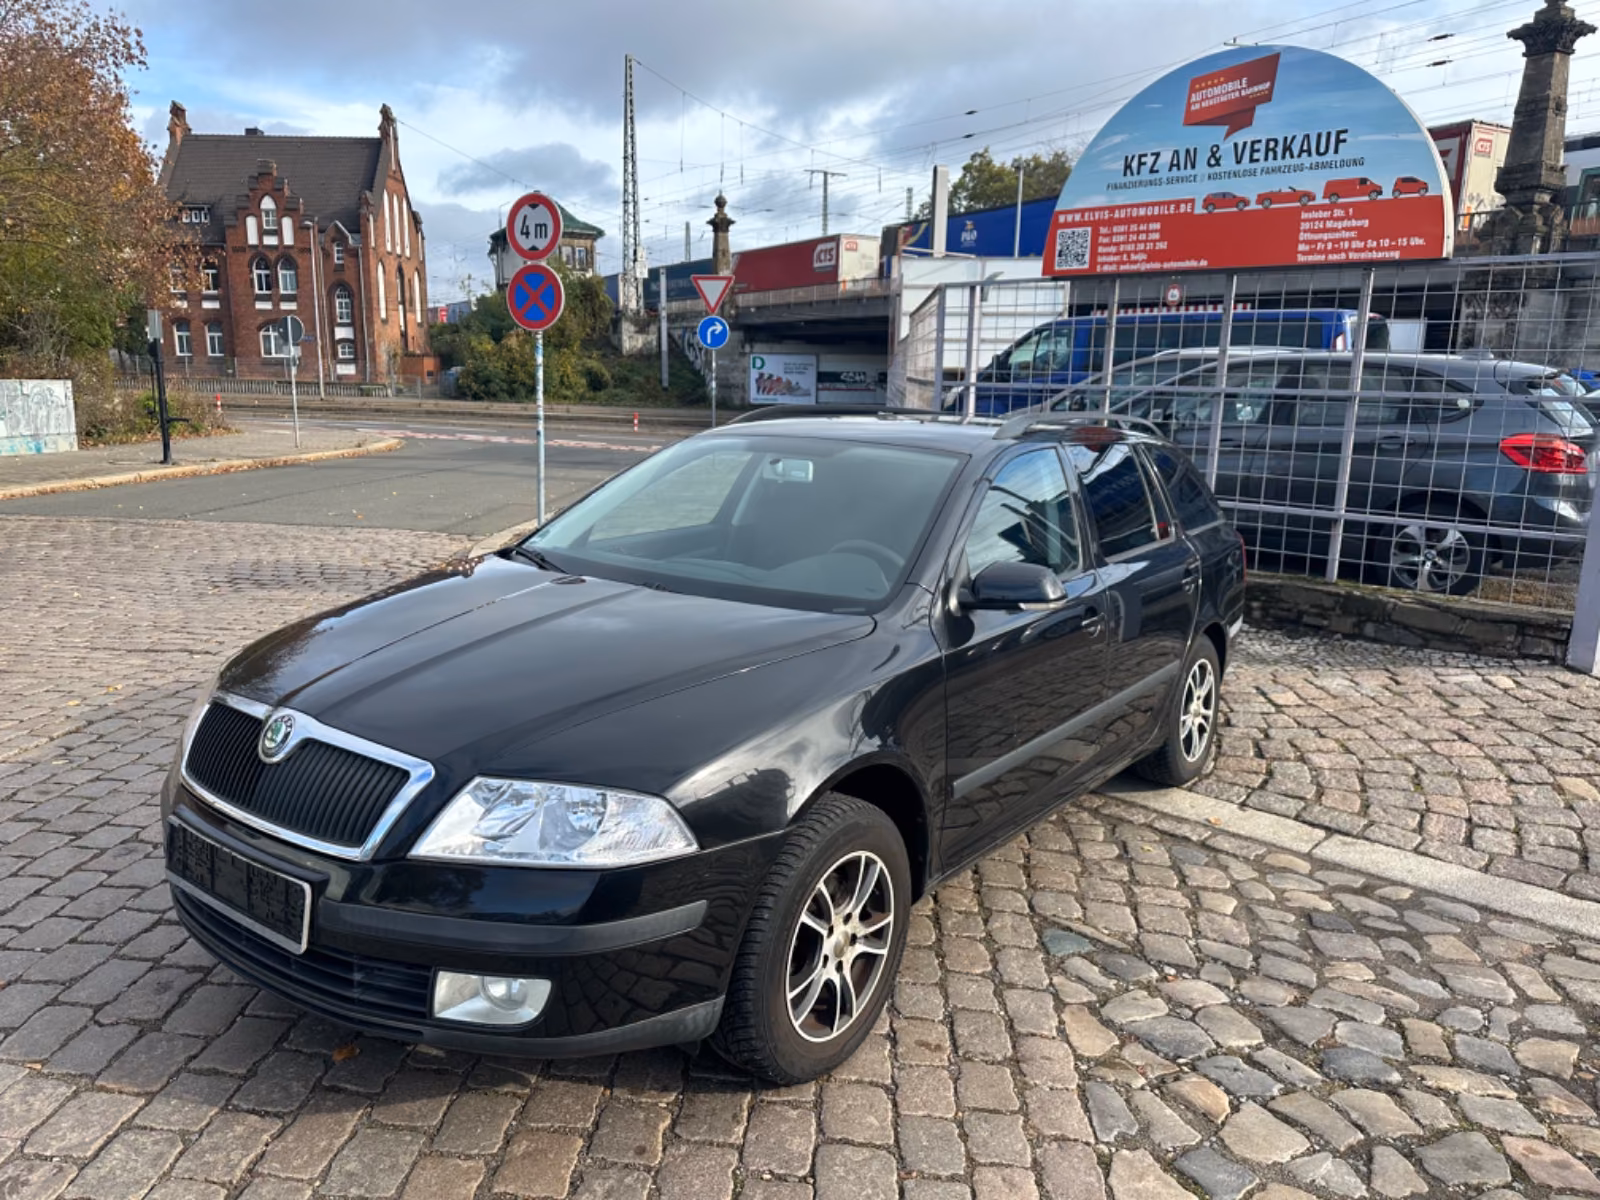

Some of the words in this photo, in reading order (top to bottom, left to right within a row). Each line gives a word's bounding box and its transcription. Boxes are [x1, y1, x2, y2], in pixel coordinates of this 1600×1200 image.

[1190, 77, 1248, 103] AUTOMOBILE
[1122, 150, 1161, 177] KFZ
[1168, 147, 1198, 173] AN
[1206, 143, 1222, 169] &
[1232, 128, 1349, 166] VERKAUF
[1106, 173, 1199, 192] FINANZIERUNGS-SERVICE
[1207, 167, 1258, 181] KOSTENLOSE
[1260, 156, 1365, 176] FAHRZEUG-ABMELDUNG
[1058, 202, 1193, 224] WWW.ELVIS-AUTOMOBILE.DE
[1325, 218, 1369, 229] Magdeburg
[520, 213, 530, 239] 4
[534, 222, 548, 239] m
[1379, 238, 1389, 247] 10
[1297, 252, 1326, 262] Termine
[1327, 251, 1346, 260] nach
[1348, 250, 1400, 260] Vereinbarung
[752, 355, 765, 370] D
